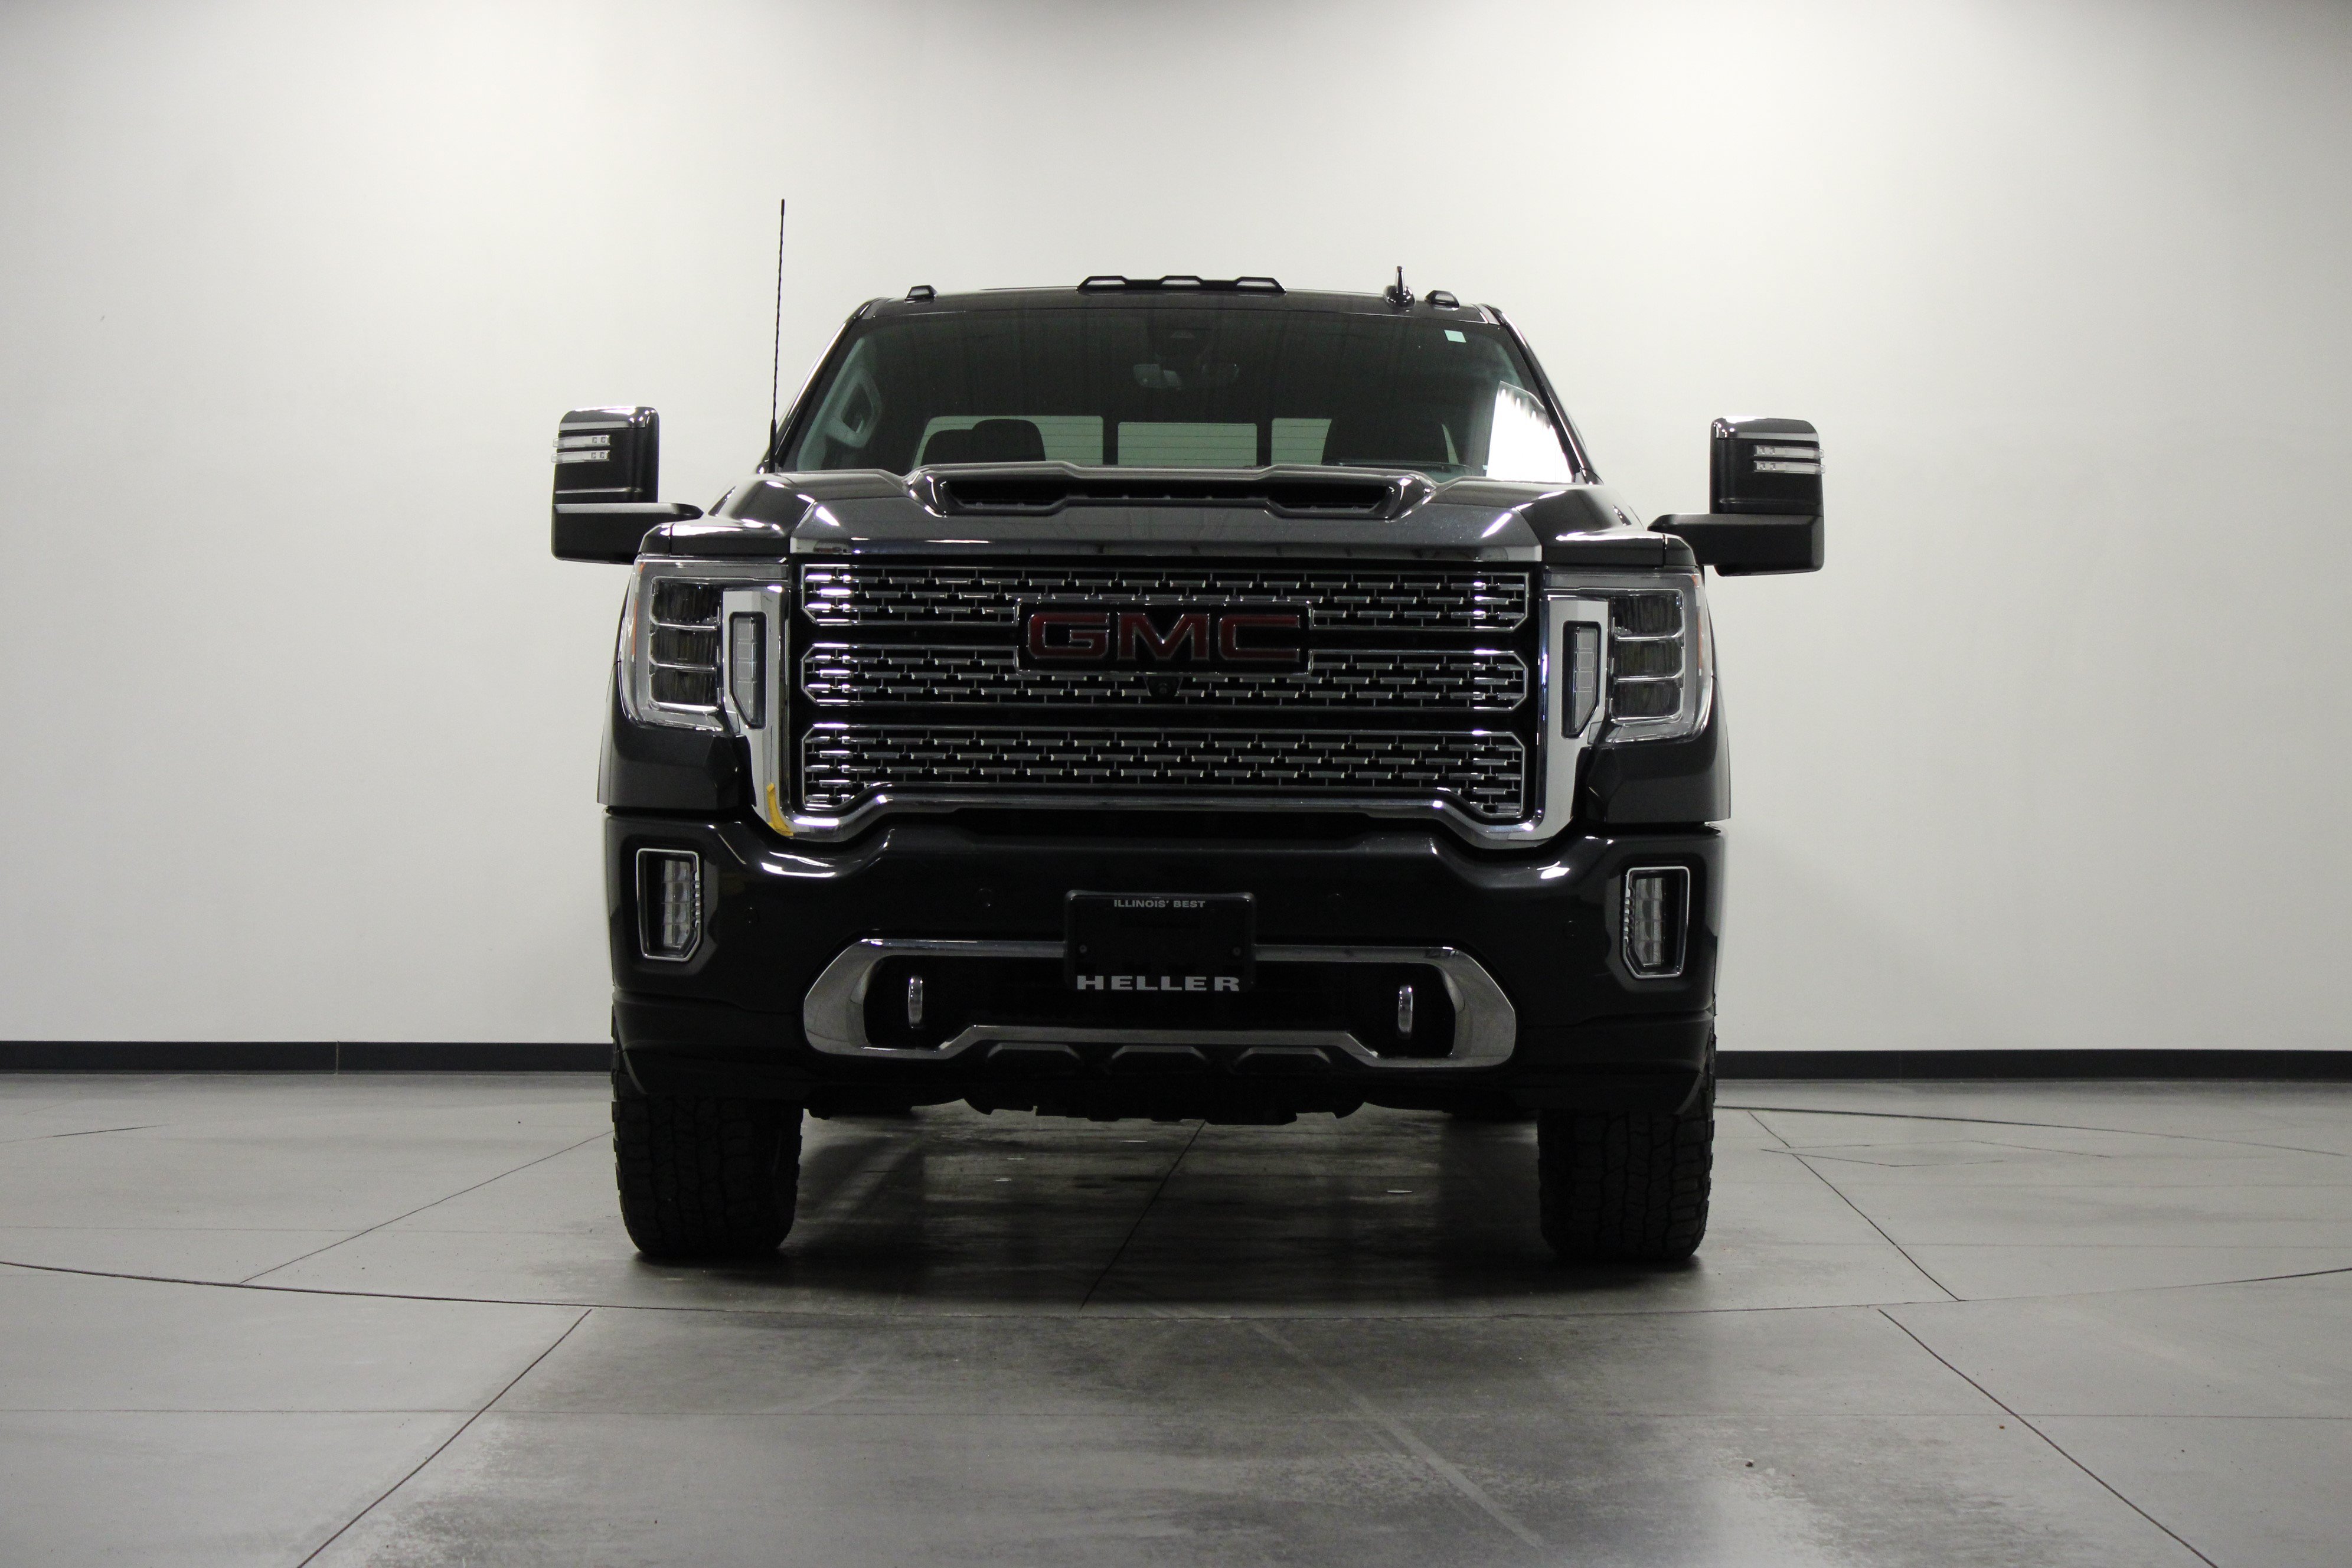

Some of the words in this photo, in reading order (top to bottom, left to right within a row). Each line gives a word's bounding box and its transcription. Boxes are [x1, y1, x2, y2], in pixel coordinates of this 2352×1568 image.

[1028, 612, 1301, 662] GMC
[1173, 900, 1206, 908] BEST
[1077, 975, 1240, 991] HELLER
